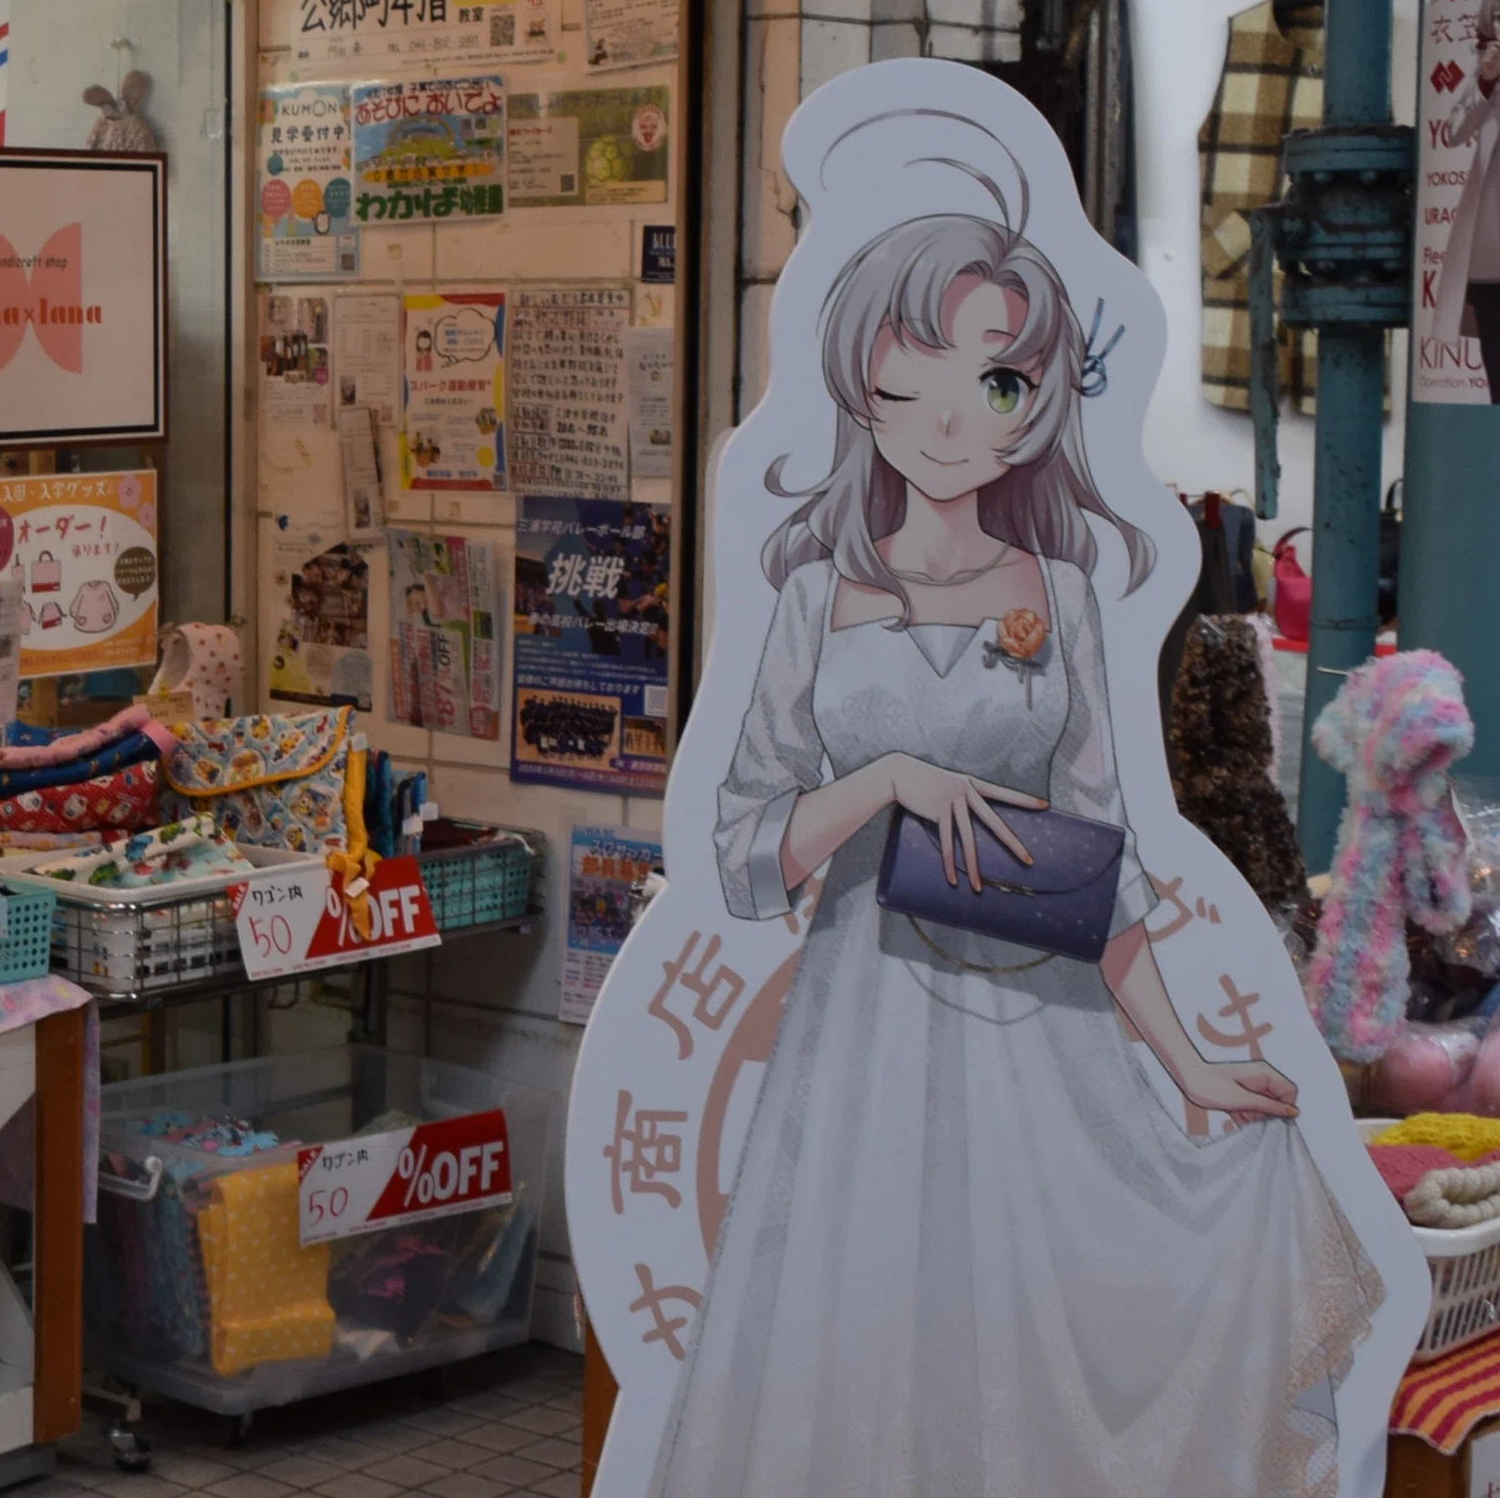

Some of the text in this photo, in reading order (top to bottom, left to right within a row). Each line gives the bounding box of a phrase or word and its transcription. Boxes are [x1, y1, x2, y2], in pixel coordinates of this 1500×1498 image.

[281, 100, 338, 117] KUMON
[356, 92, 502, 125] あそびに おいでよ
[44, 254, 68, 273] shop
[545, 552, 626, 599] 挑戦
[233, 884, 246, 911] SALE
[252, 883, 303, 907] ワゴン内
[248, 914, 292, 958] 50
[299, 1149, 319, 1179] SALE
[322, 1148, 369, 1172] ワゴン内
[398, 1141, 504, 1209] %OFF
[307, 1186, 348, 1227] 50
